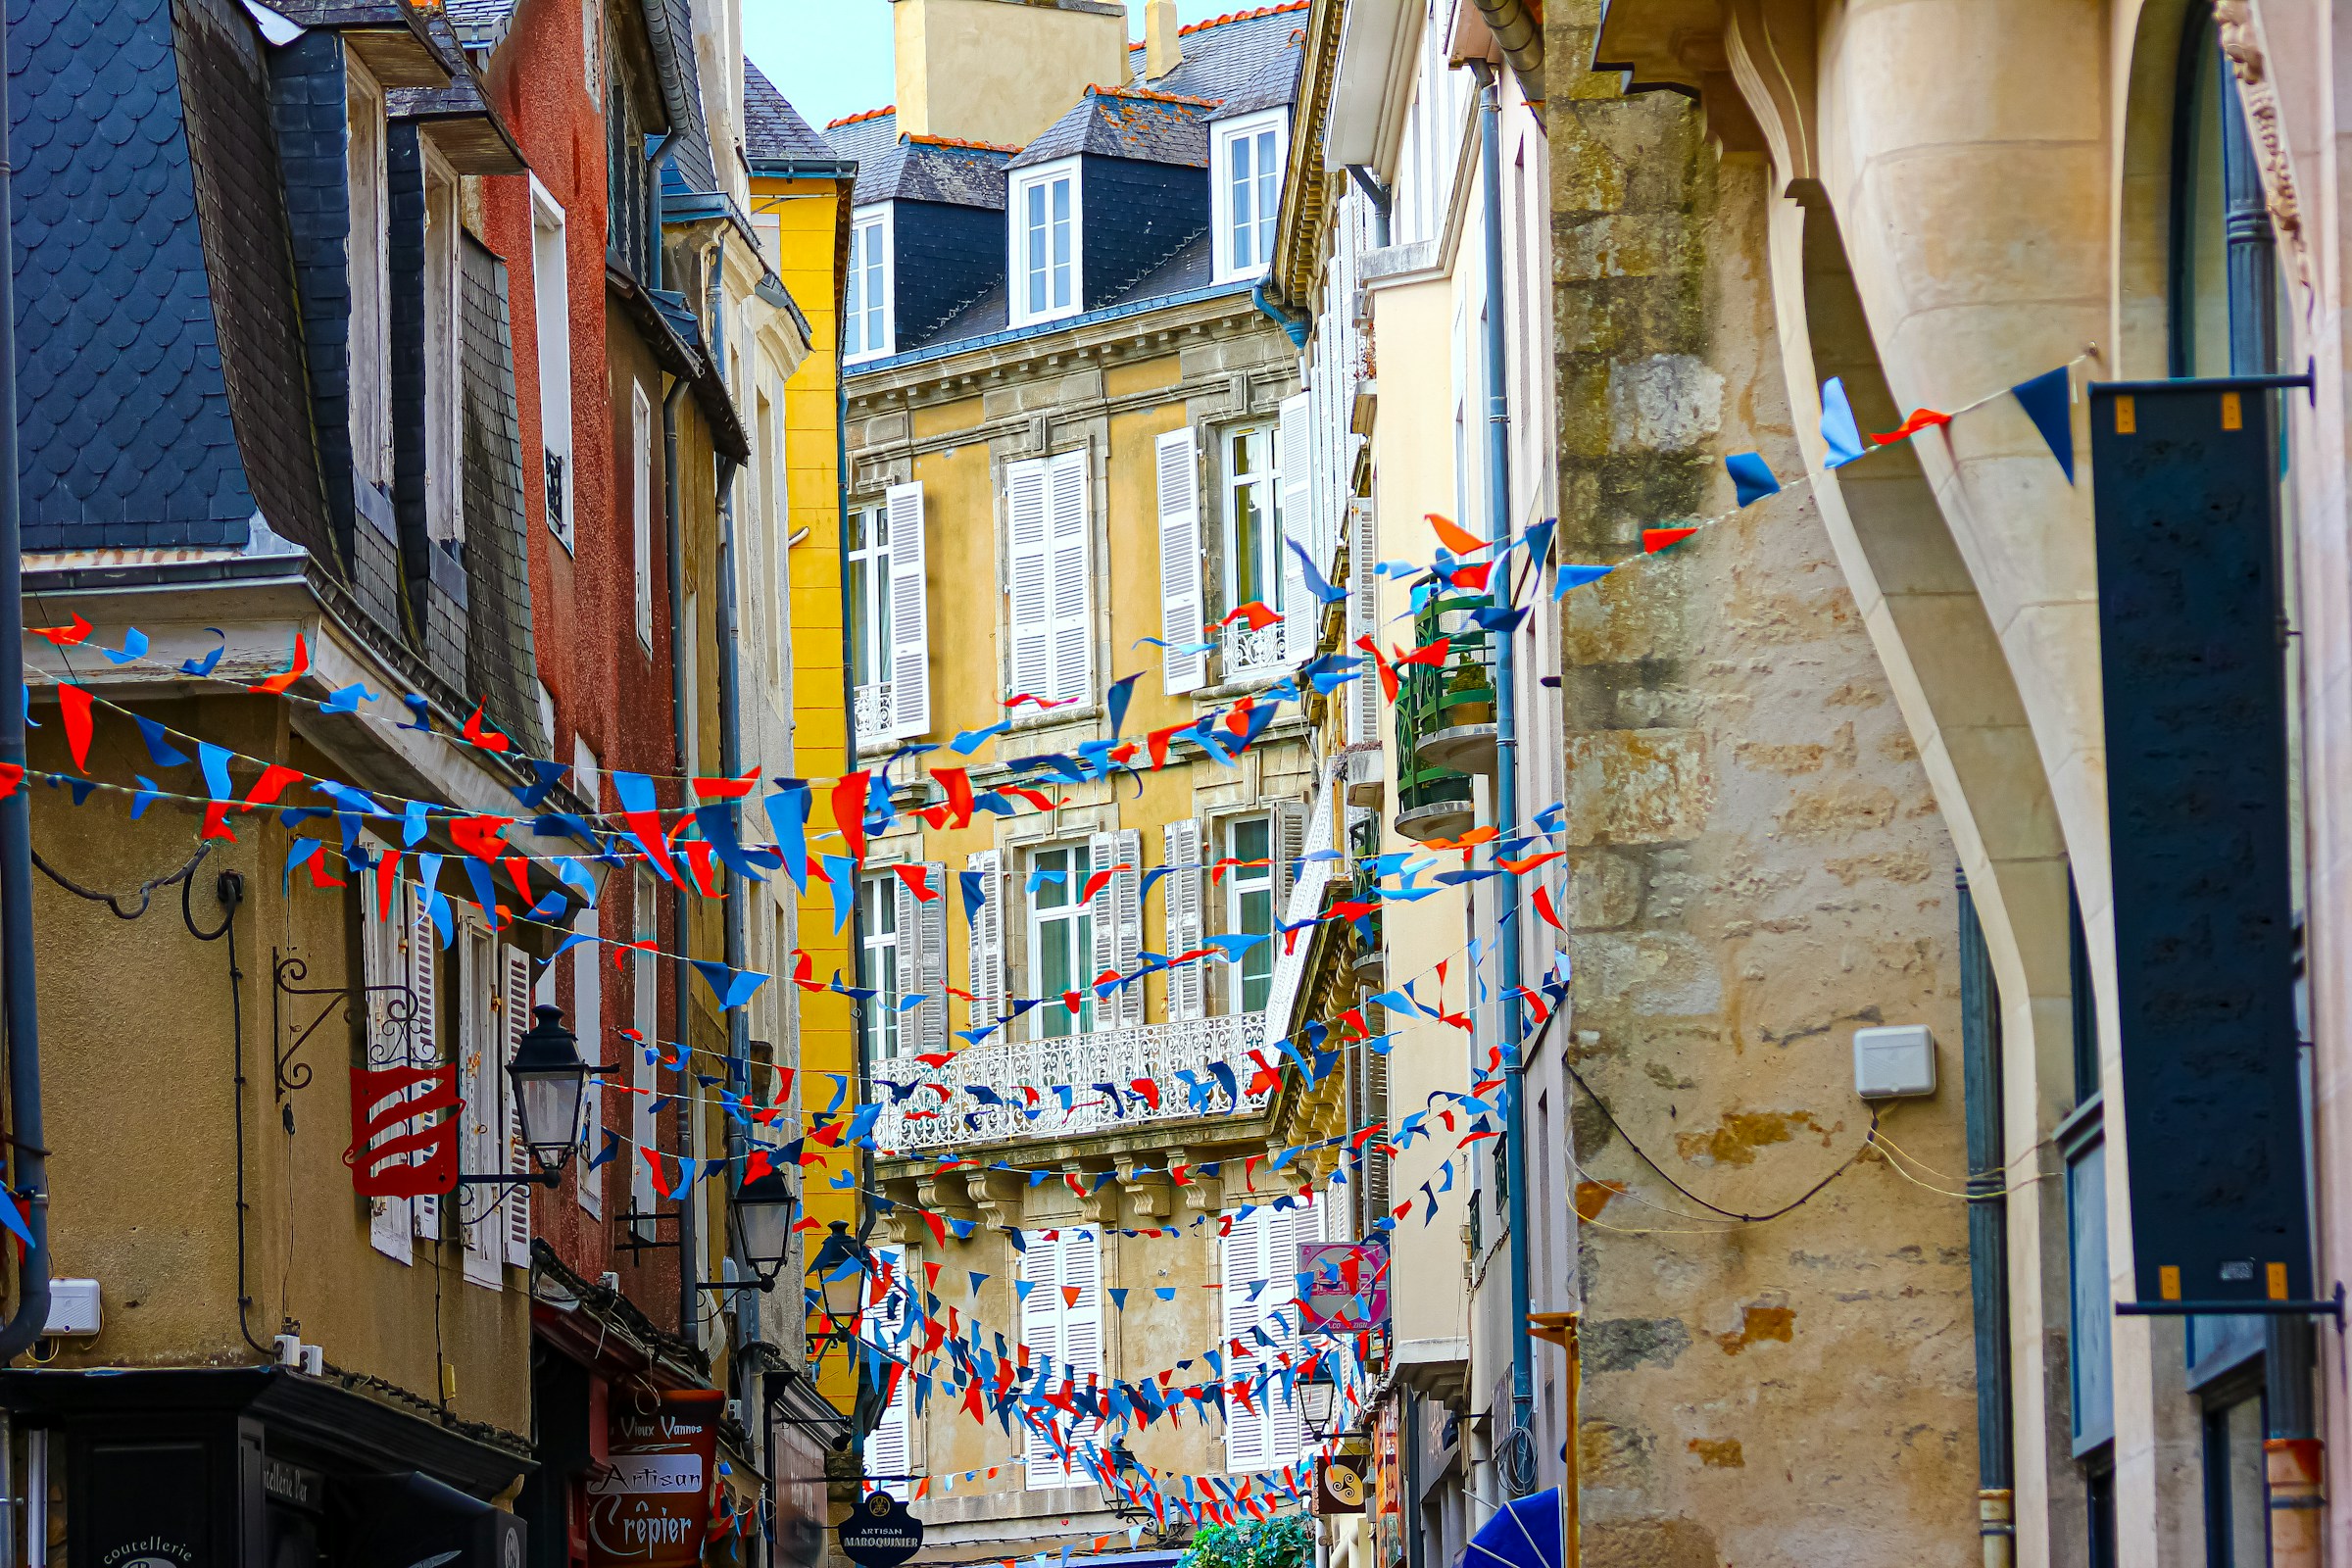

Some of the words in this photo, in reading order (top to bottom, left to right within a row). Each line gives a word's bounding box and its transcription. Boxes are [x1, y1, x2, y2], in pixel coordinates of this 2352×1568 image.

[620, 1416, 655, 1439] Vieux
[590, 1463, 701, 1493] Artisan
[590, 1494, 692, 1559] Crêpier
[103, 1536, 192, 1565] coutellerie
[845, 1537, 918, 1548] MAROQUINIER
